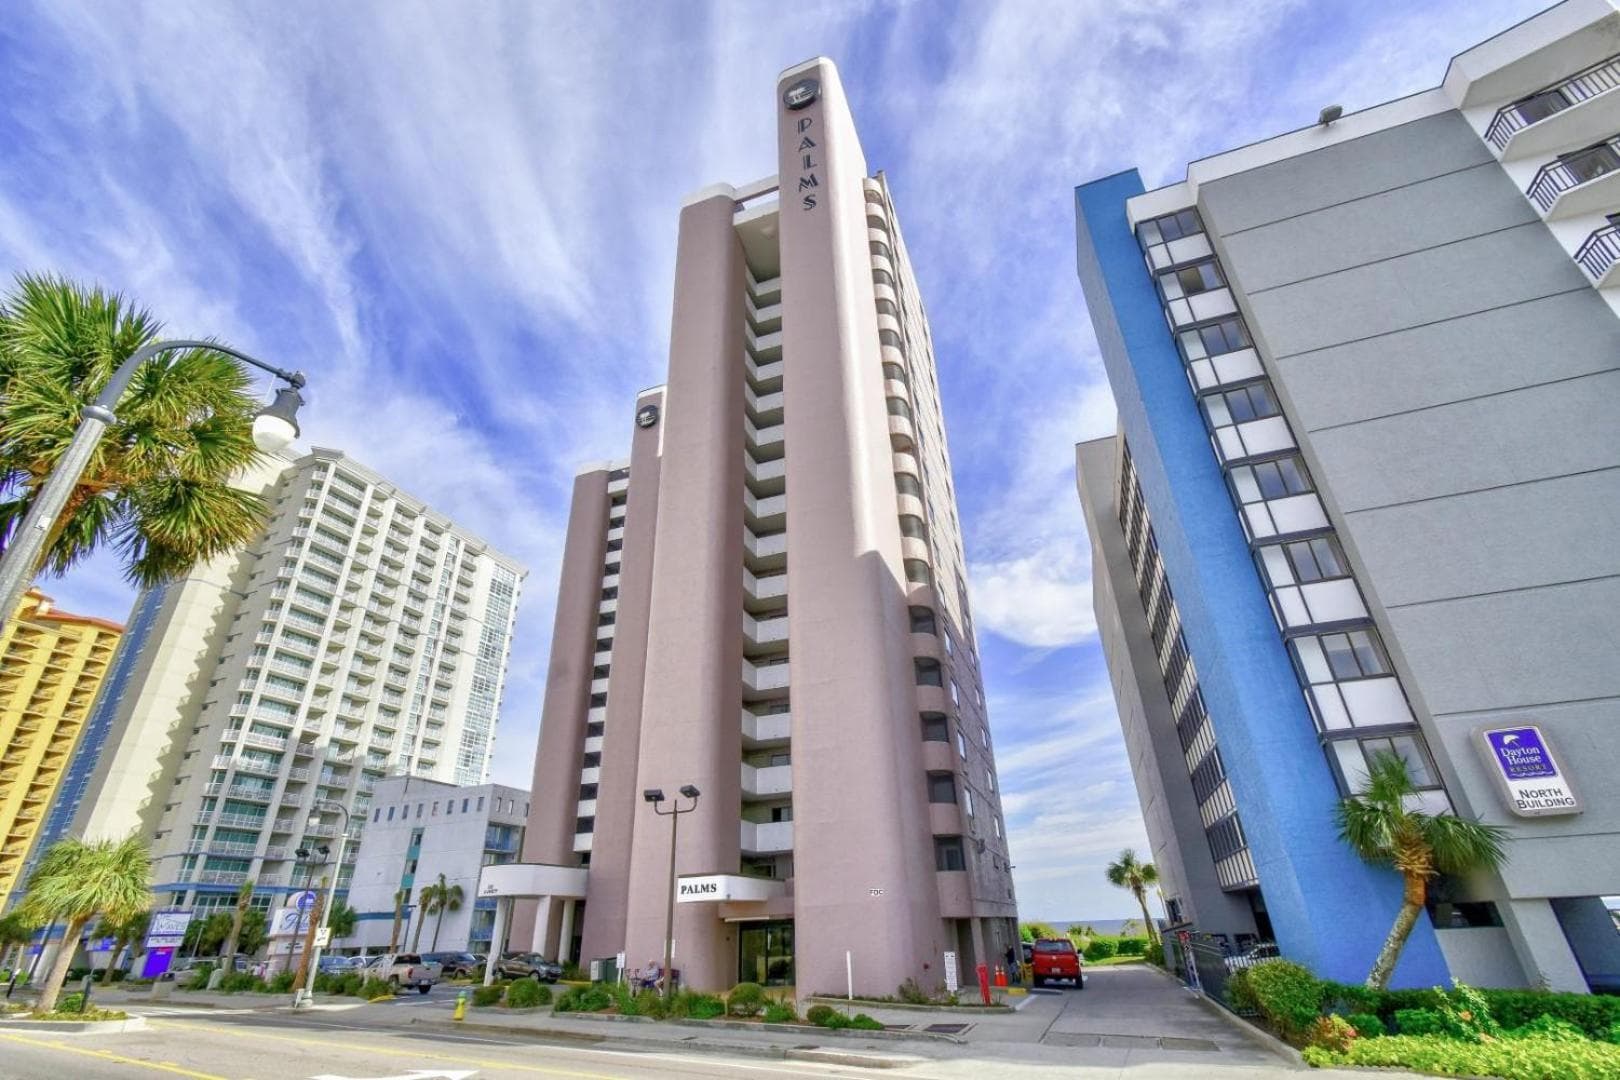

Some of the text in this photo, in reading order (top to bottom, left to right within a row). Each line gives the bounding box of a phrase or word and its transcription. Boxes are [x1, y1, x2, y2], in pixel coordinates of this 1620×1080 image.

[798, 118, 819, 211] PALMS
[1500, 747, 1541, 758] Dayton
[1507, 756, 1542, 766] House
[1510, 763, 1547, 773] RESORT
[1519, 787, 1563, 799] NORTH
[1516, 797, 1575, 809] BUILDING
[680, 883, 717, 895] PALMS
